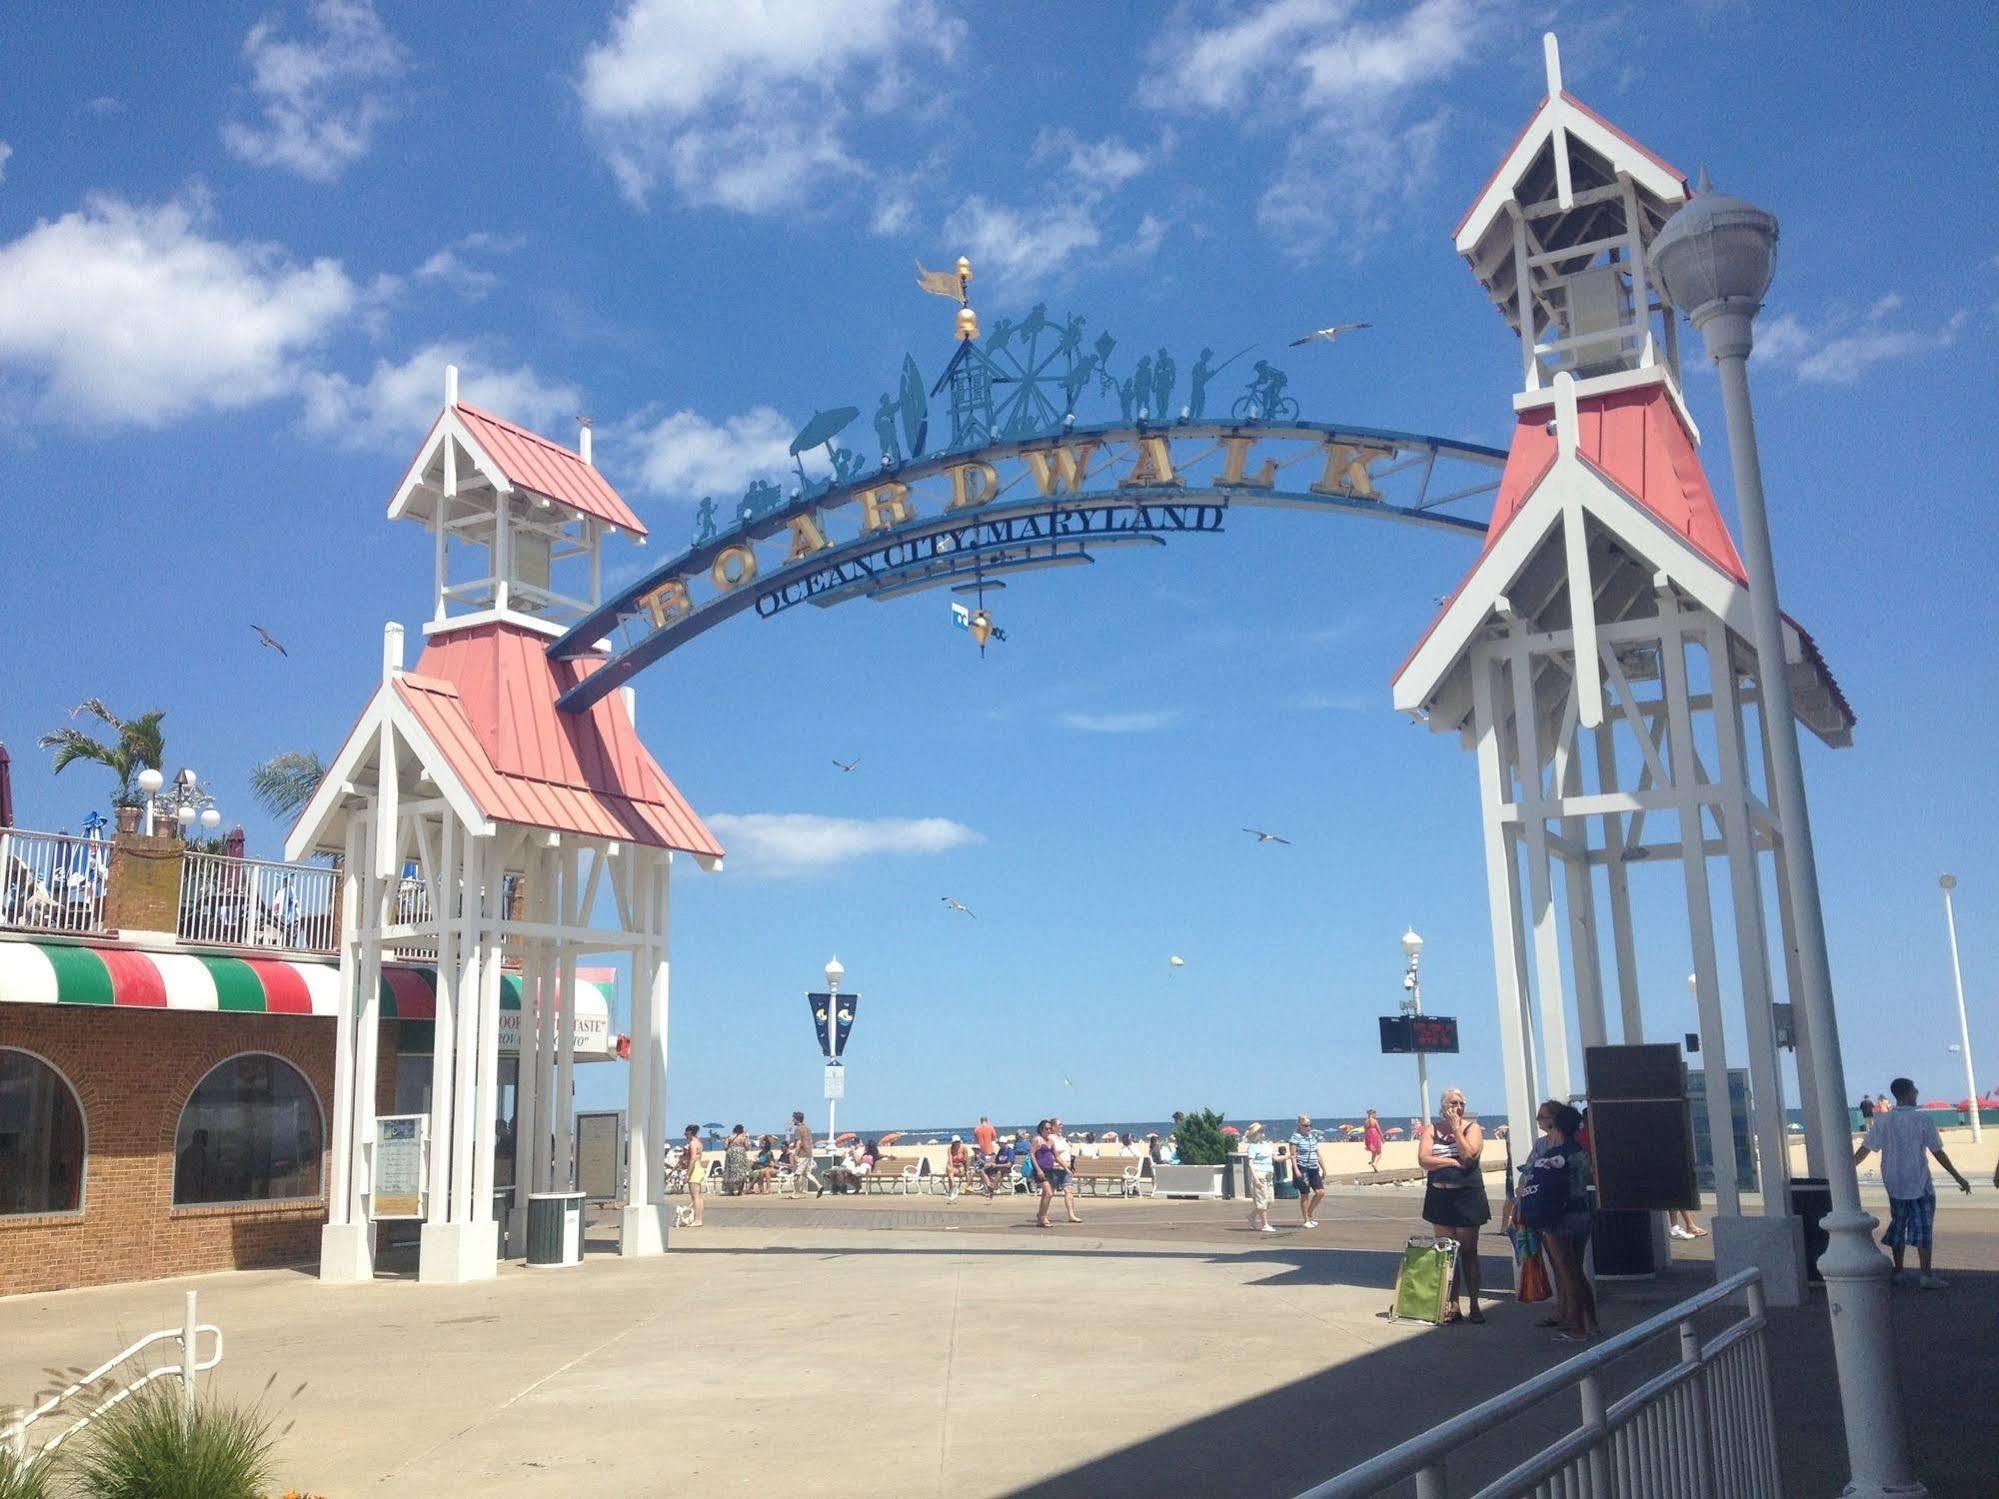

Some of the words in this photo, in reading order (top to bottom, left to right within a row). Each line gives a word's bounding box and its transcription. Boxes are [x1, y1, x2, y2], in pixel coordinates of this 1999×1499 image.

[636, 434, 1397, 630] BOARDWALK
[755, 553, 876, 618] OCEAN
[978, 505, 1225, 546] MARYLAND
